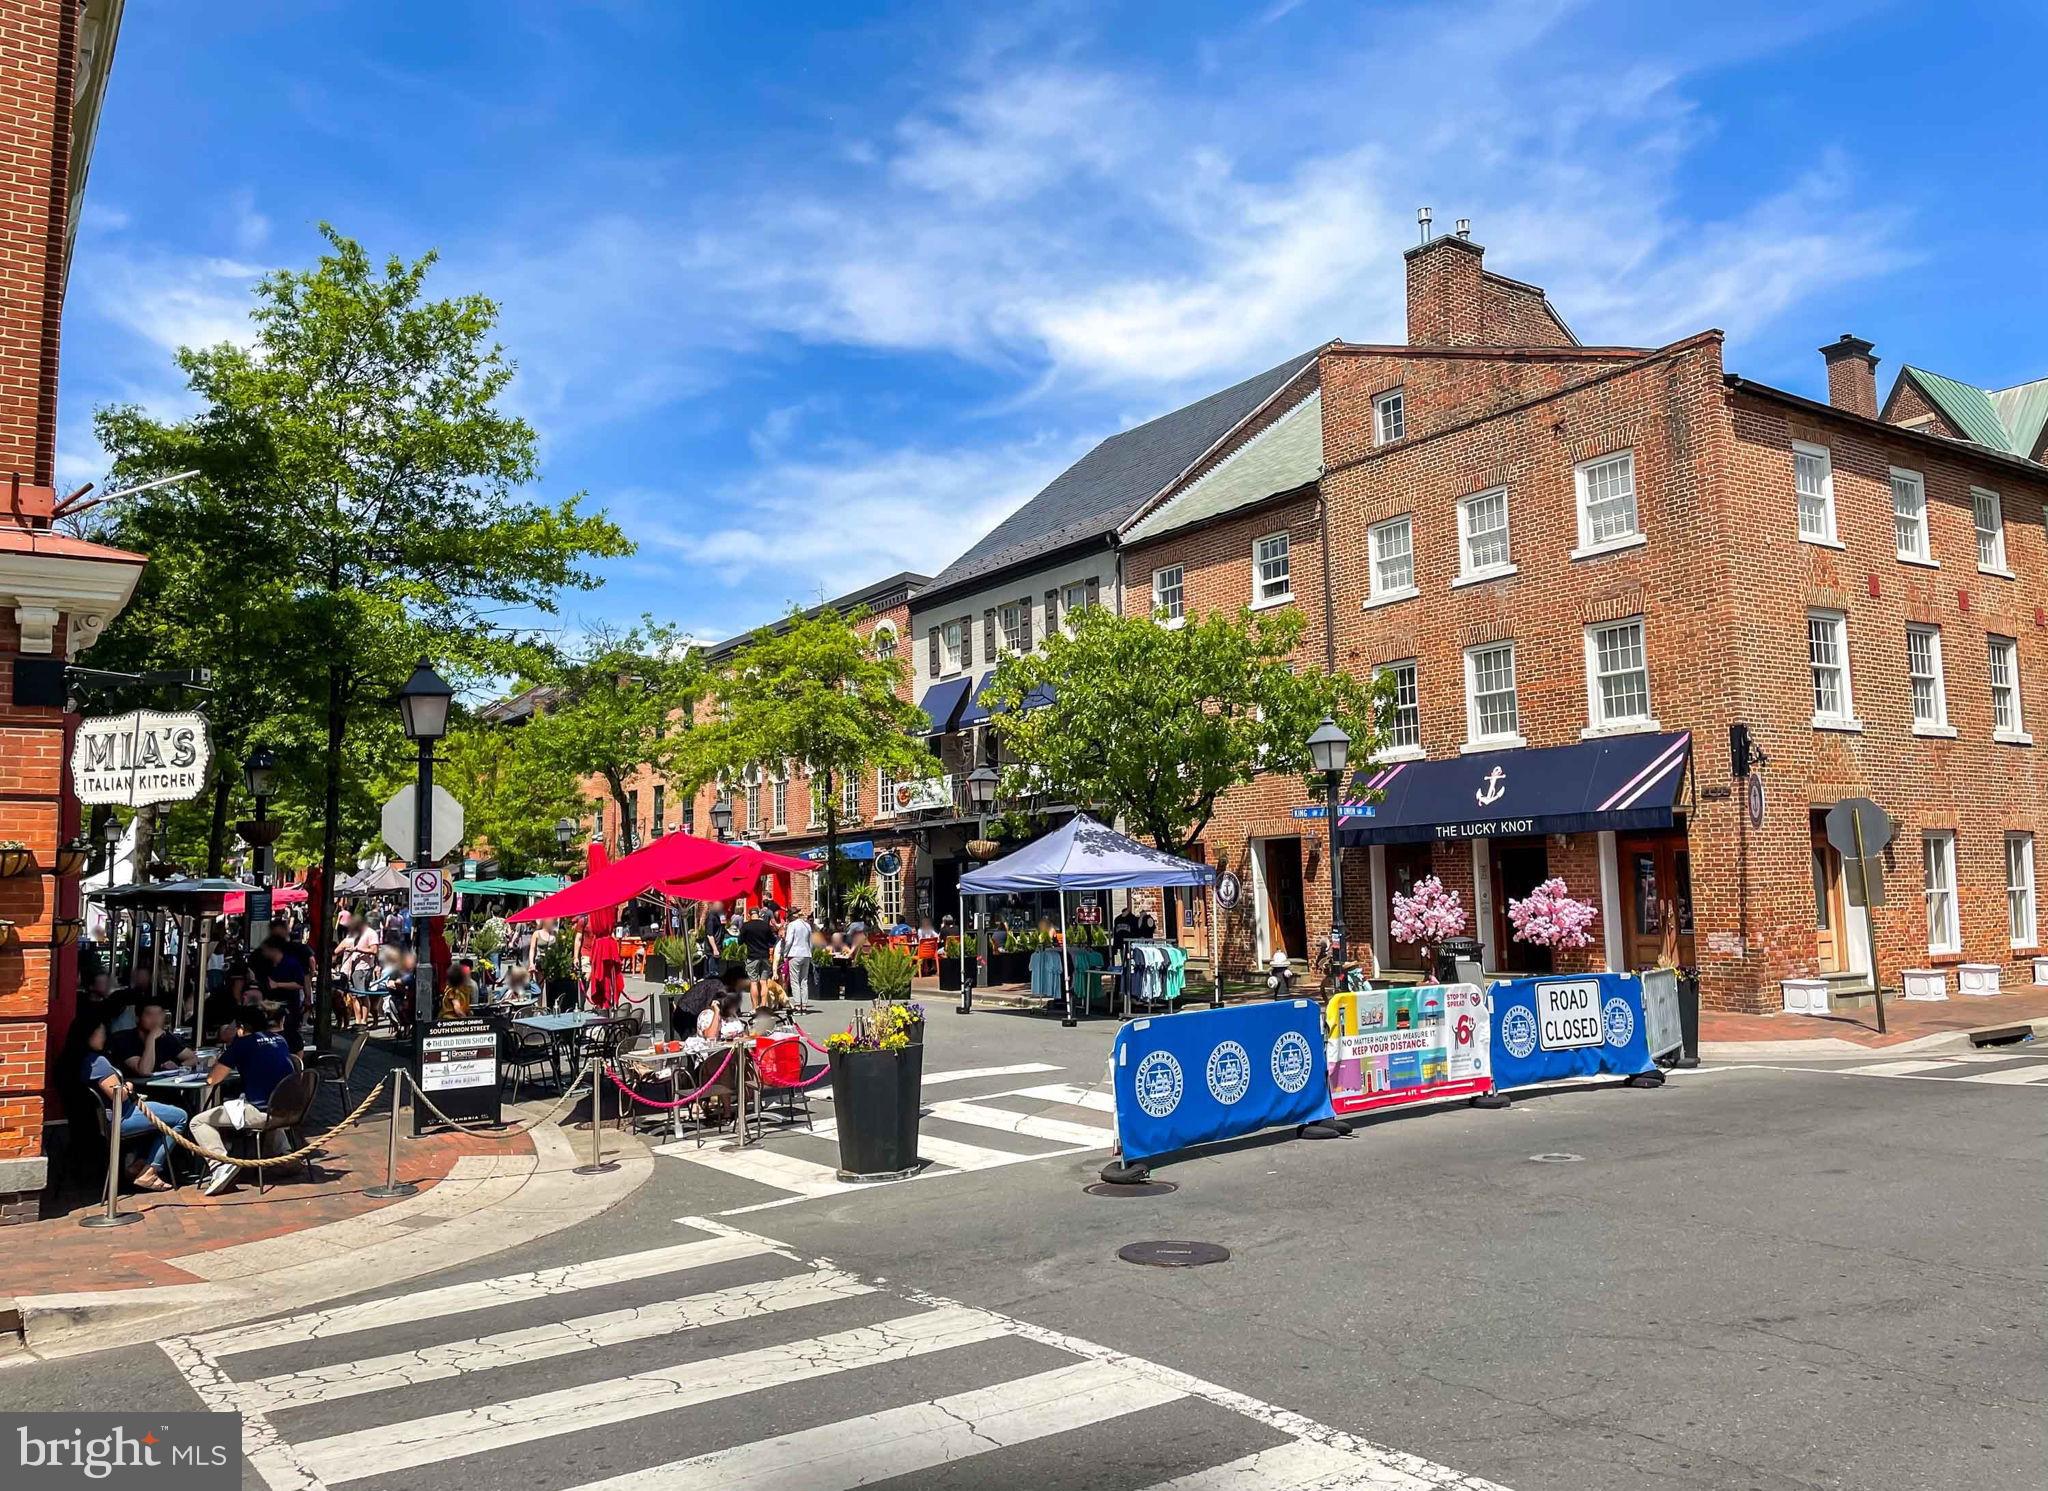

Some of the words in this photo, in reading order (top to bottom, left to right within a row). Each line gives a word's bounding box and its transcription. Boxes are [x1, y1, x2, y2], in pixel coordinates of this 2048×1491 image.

[84, 728, 196, 772] MIA'S
[83, 776, 133, 792] ITALIAN
[139, 773, 195, 789] KITCHEN
[1294, 809, 1308, 818] KING
[1435, 825, 1457, 838] THE
[1461, 822, 1497, 836] LUCKY
[1501, 820, 1533, 833] KNOT
[1549, 989, 1588, 1011] ROAD
[1545, 1017, 1598, 1041] CLOSED
[471, 1036, 488, 1044] SHOP
[1342, 1039, 1352, 1047] NO
[1354, 1036, 1374, 1045] MATTER
[1375, 1035, 1388, 1043] HOW
[1403, 1031, 1428, 1040] MEASURE
[1352, 1046, 1368, 1056] KEEP
[1369, 1043, 1389, 1053] YOUR
[1390, 1039, 1429, 1051] DISTANCE.
